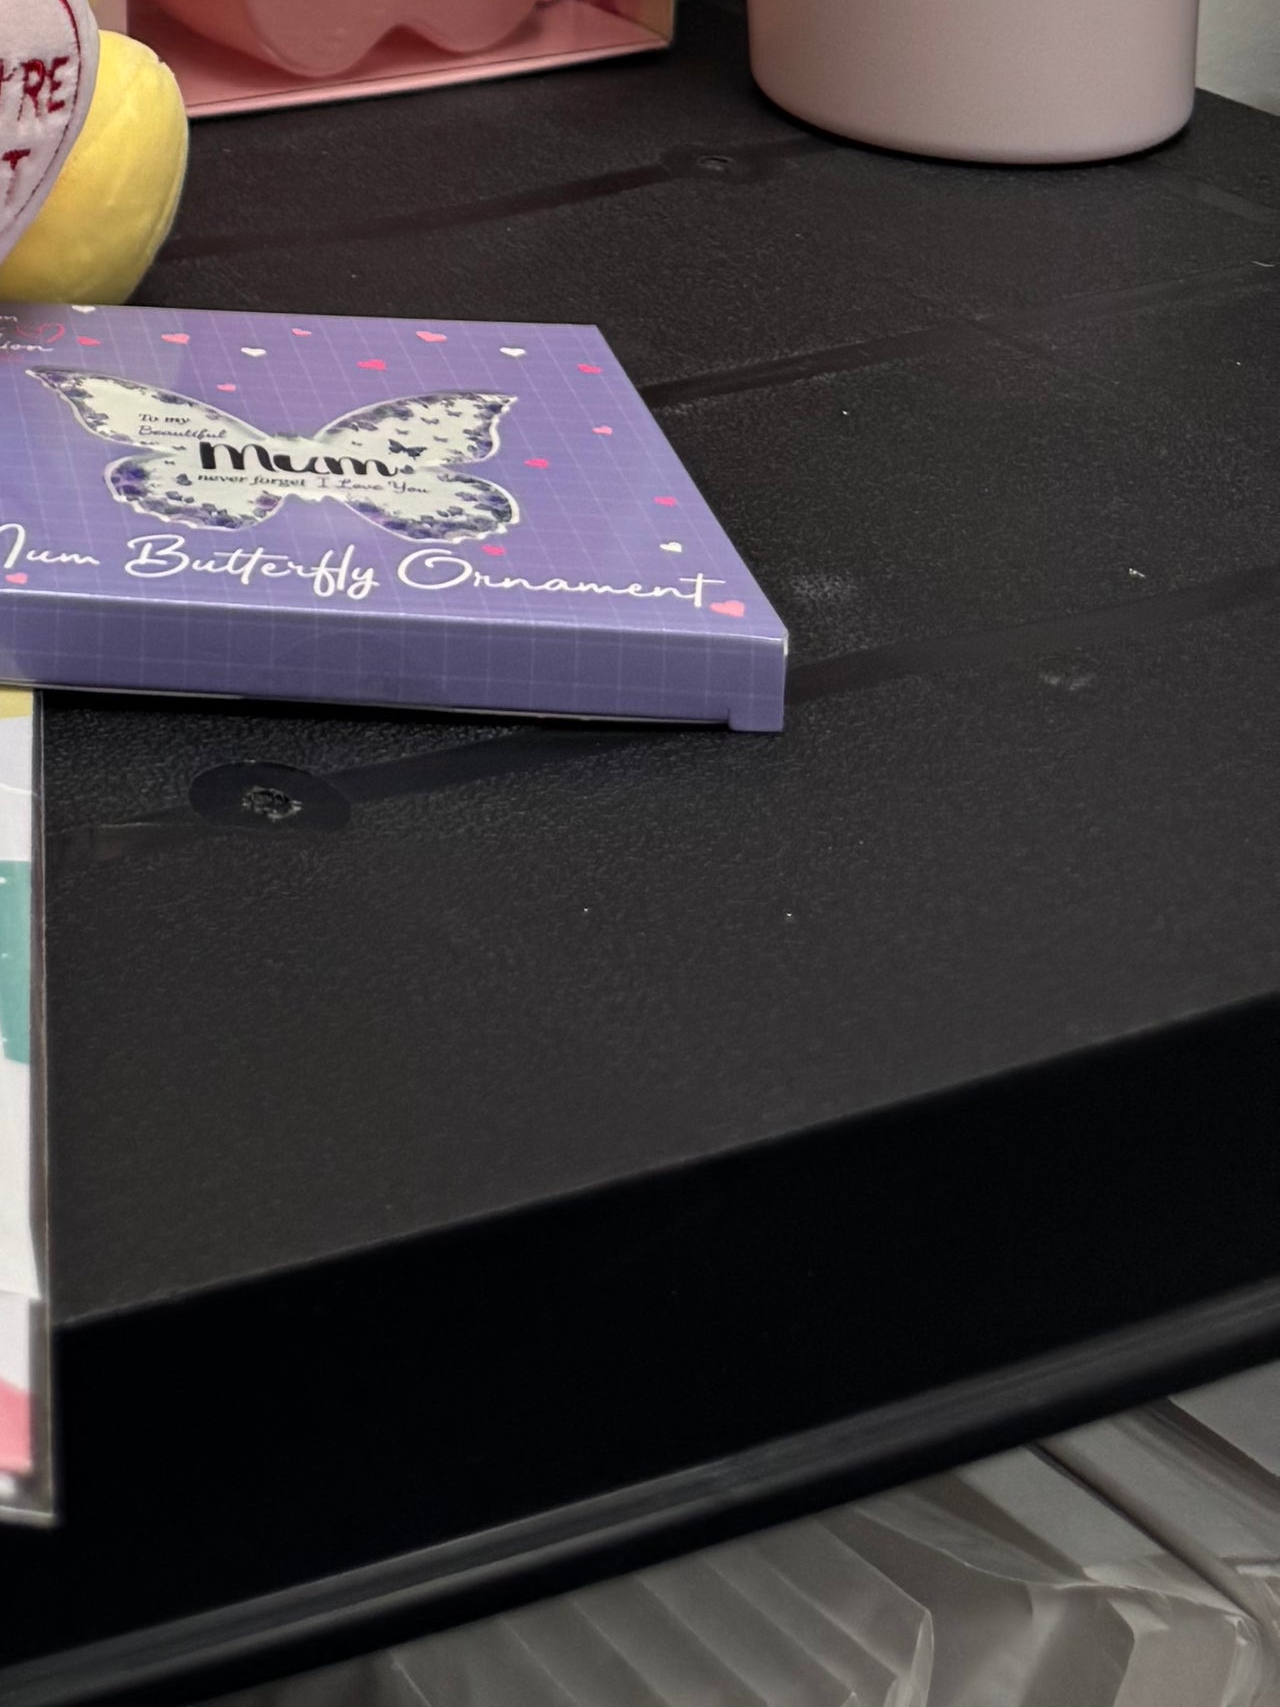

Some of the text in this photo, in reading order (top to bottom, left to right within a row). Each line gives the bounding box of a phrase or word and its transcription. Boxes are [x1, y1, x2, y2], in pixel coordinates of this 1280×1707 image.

[138, 413, 191, 425] To my
[138, 425, 227, 439] Beautiful
[198, 473, 248, 485] never
[251, 474, 305, 487] forget
[125, 532, 380, 602] Butterfly
[398, 548, 727, 609] Ornament
